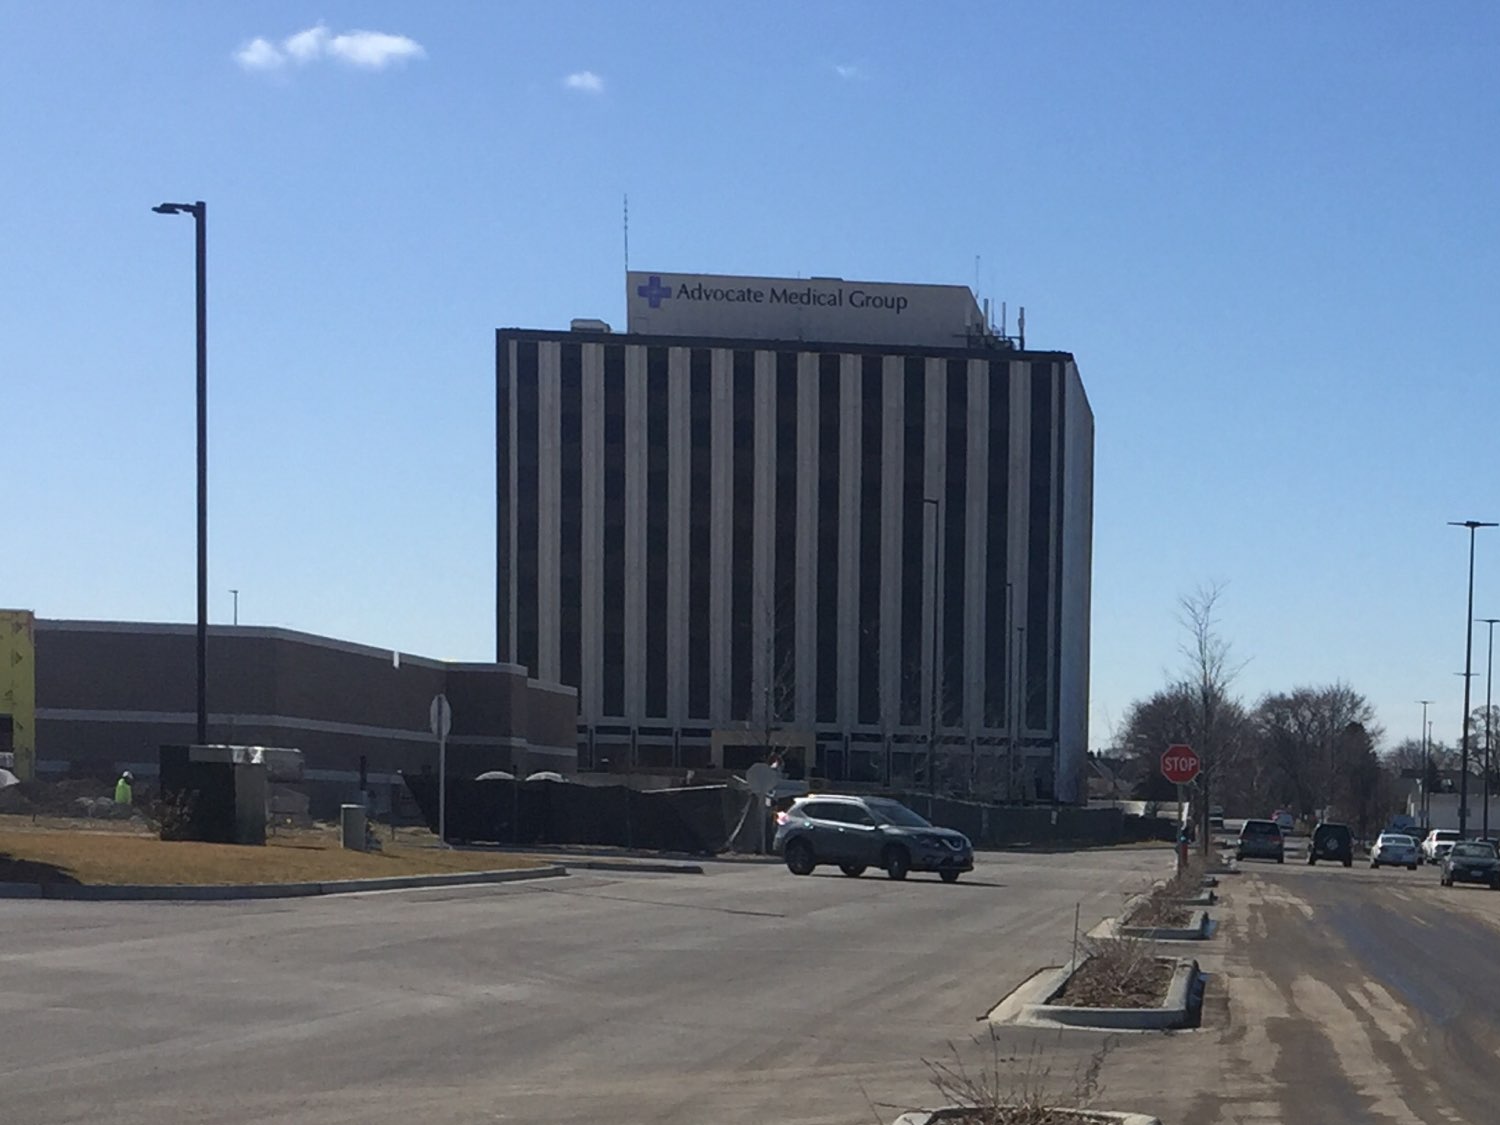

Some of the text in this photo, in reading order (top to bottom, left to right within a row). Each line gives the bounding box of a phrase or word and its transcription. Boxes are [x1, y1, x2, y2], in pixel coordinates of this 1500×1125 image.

[677, 284, 908, 314] Advocate Medical Group
[1164, 757, 1197, 771] STOP
